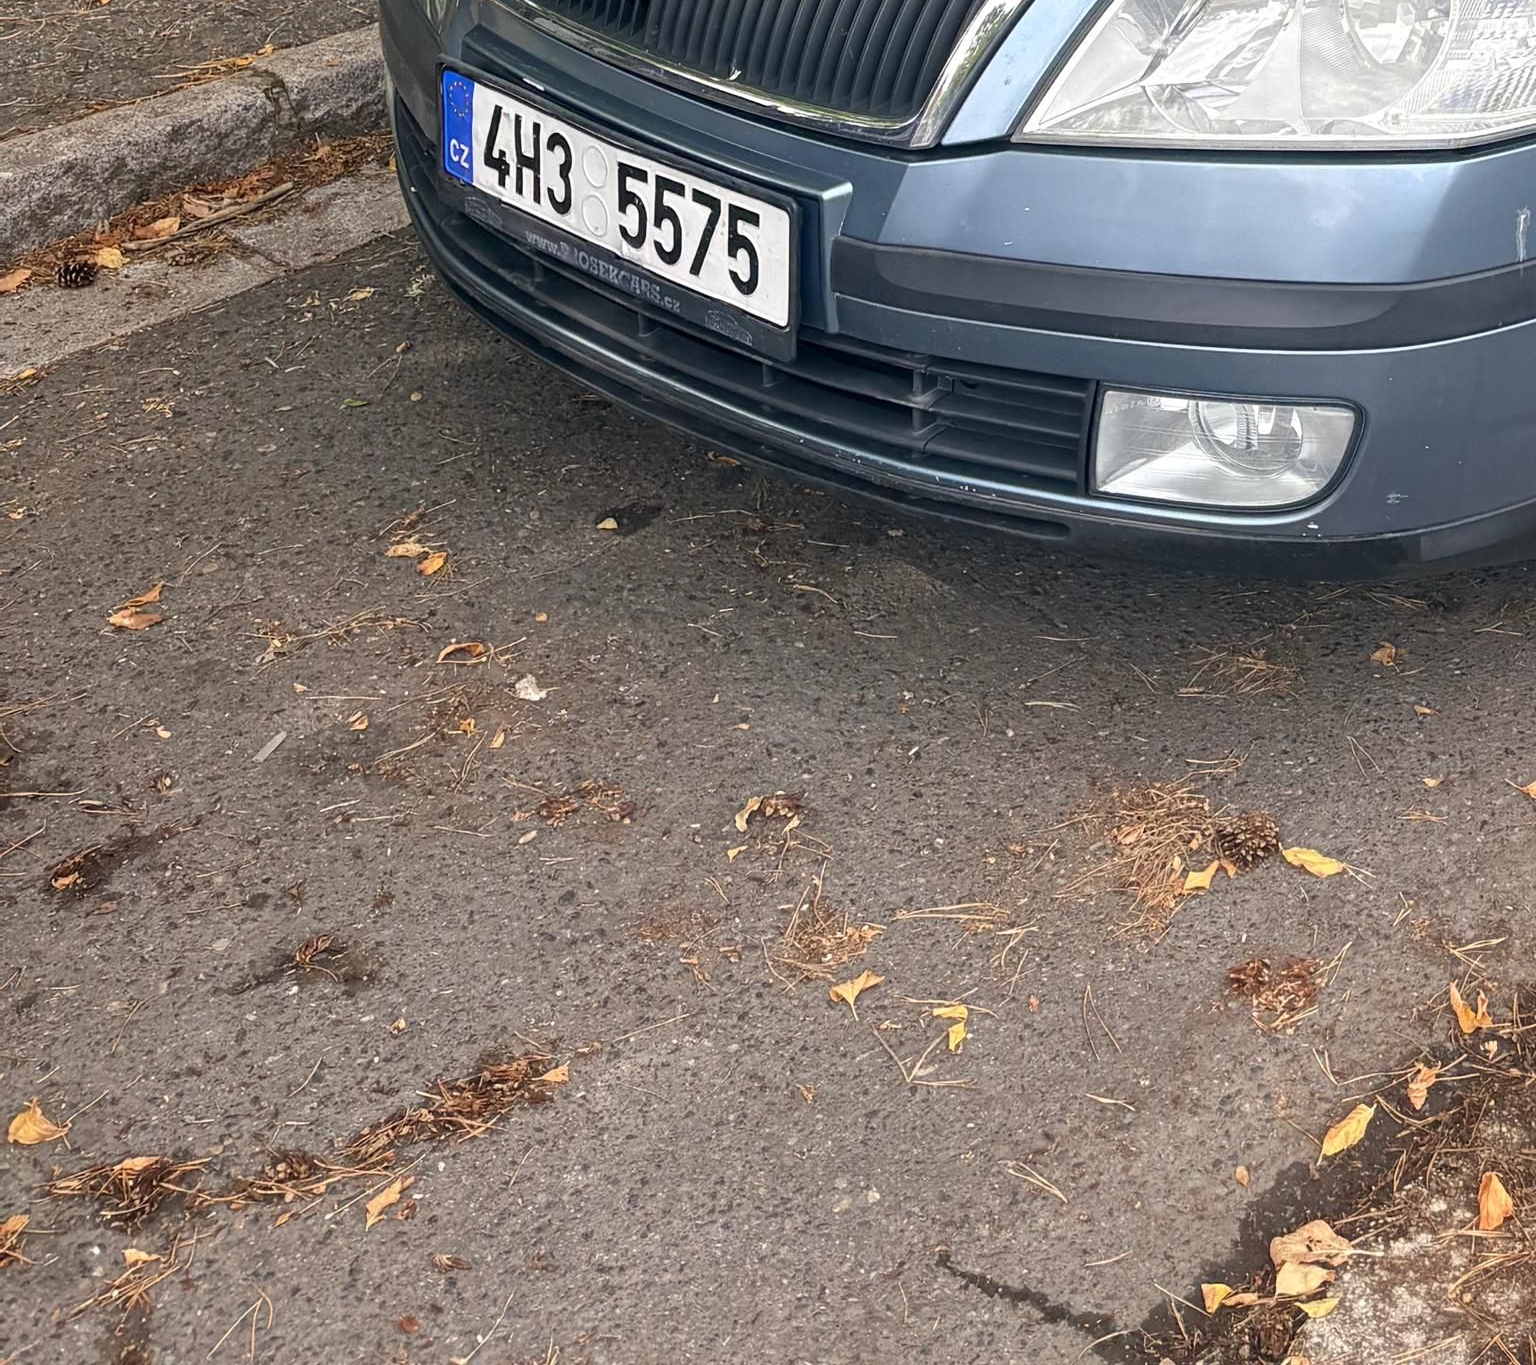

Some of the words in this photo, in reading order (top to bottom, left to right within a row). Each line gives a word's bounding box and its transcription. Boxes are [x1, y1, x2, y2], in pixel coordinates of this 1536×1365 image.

[449, 138, 470, 168] CZ
[483, 104, 573, 215] 4H3
[617, 161, 760, 296] 5575
